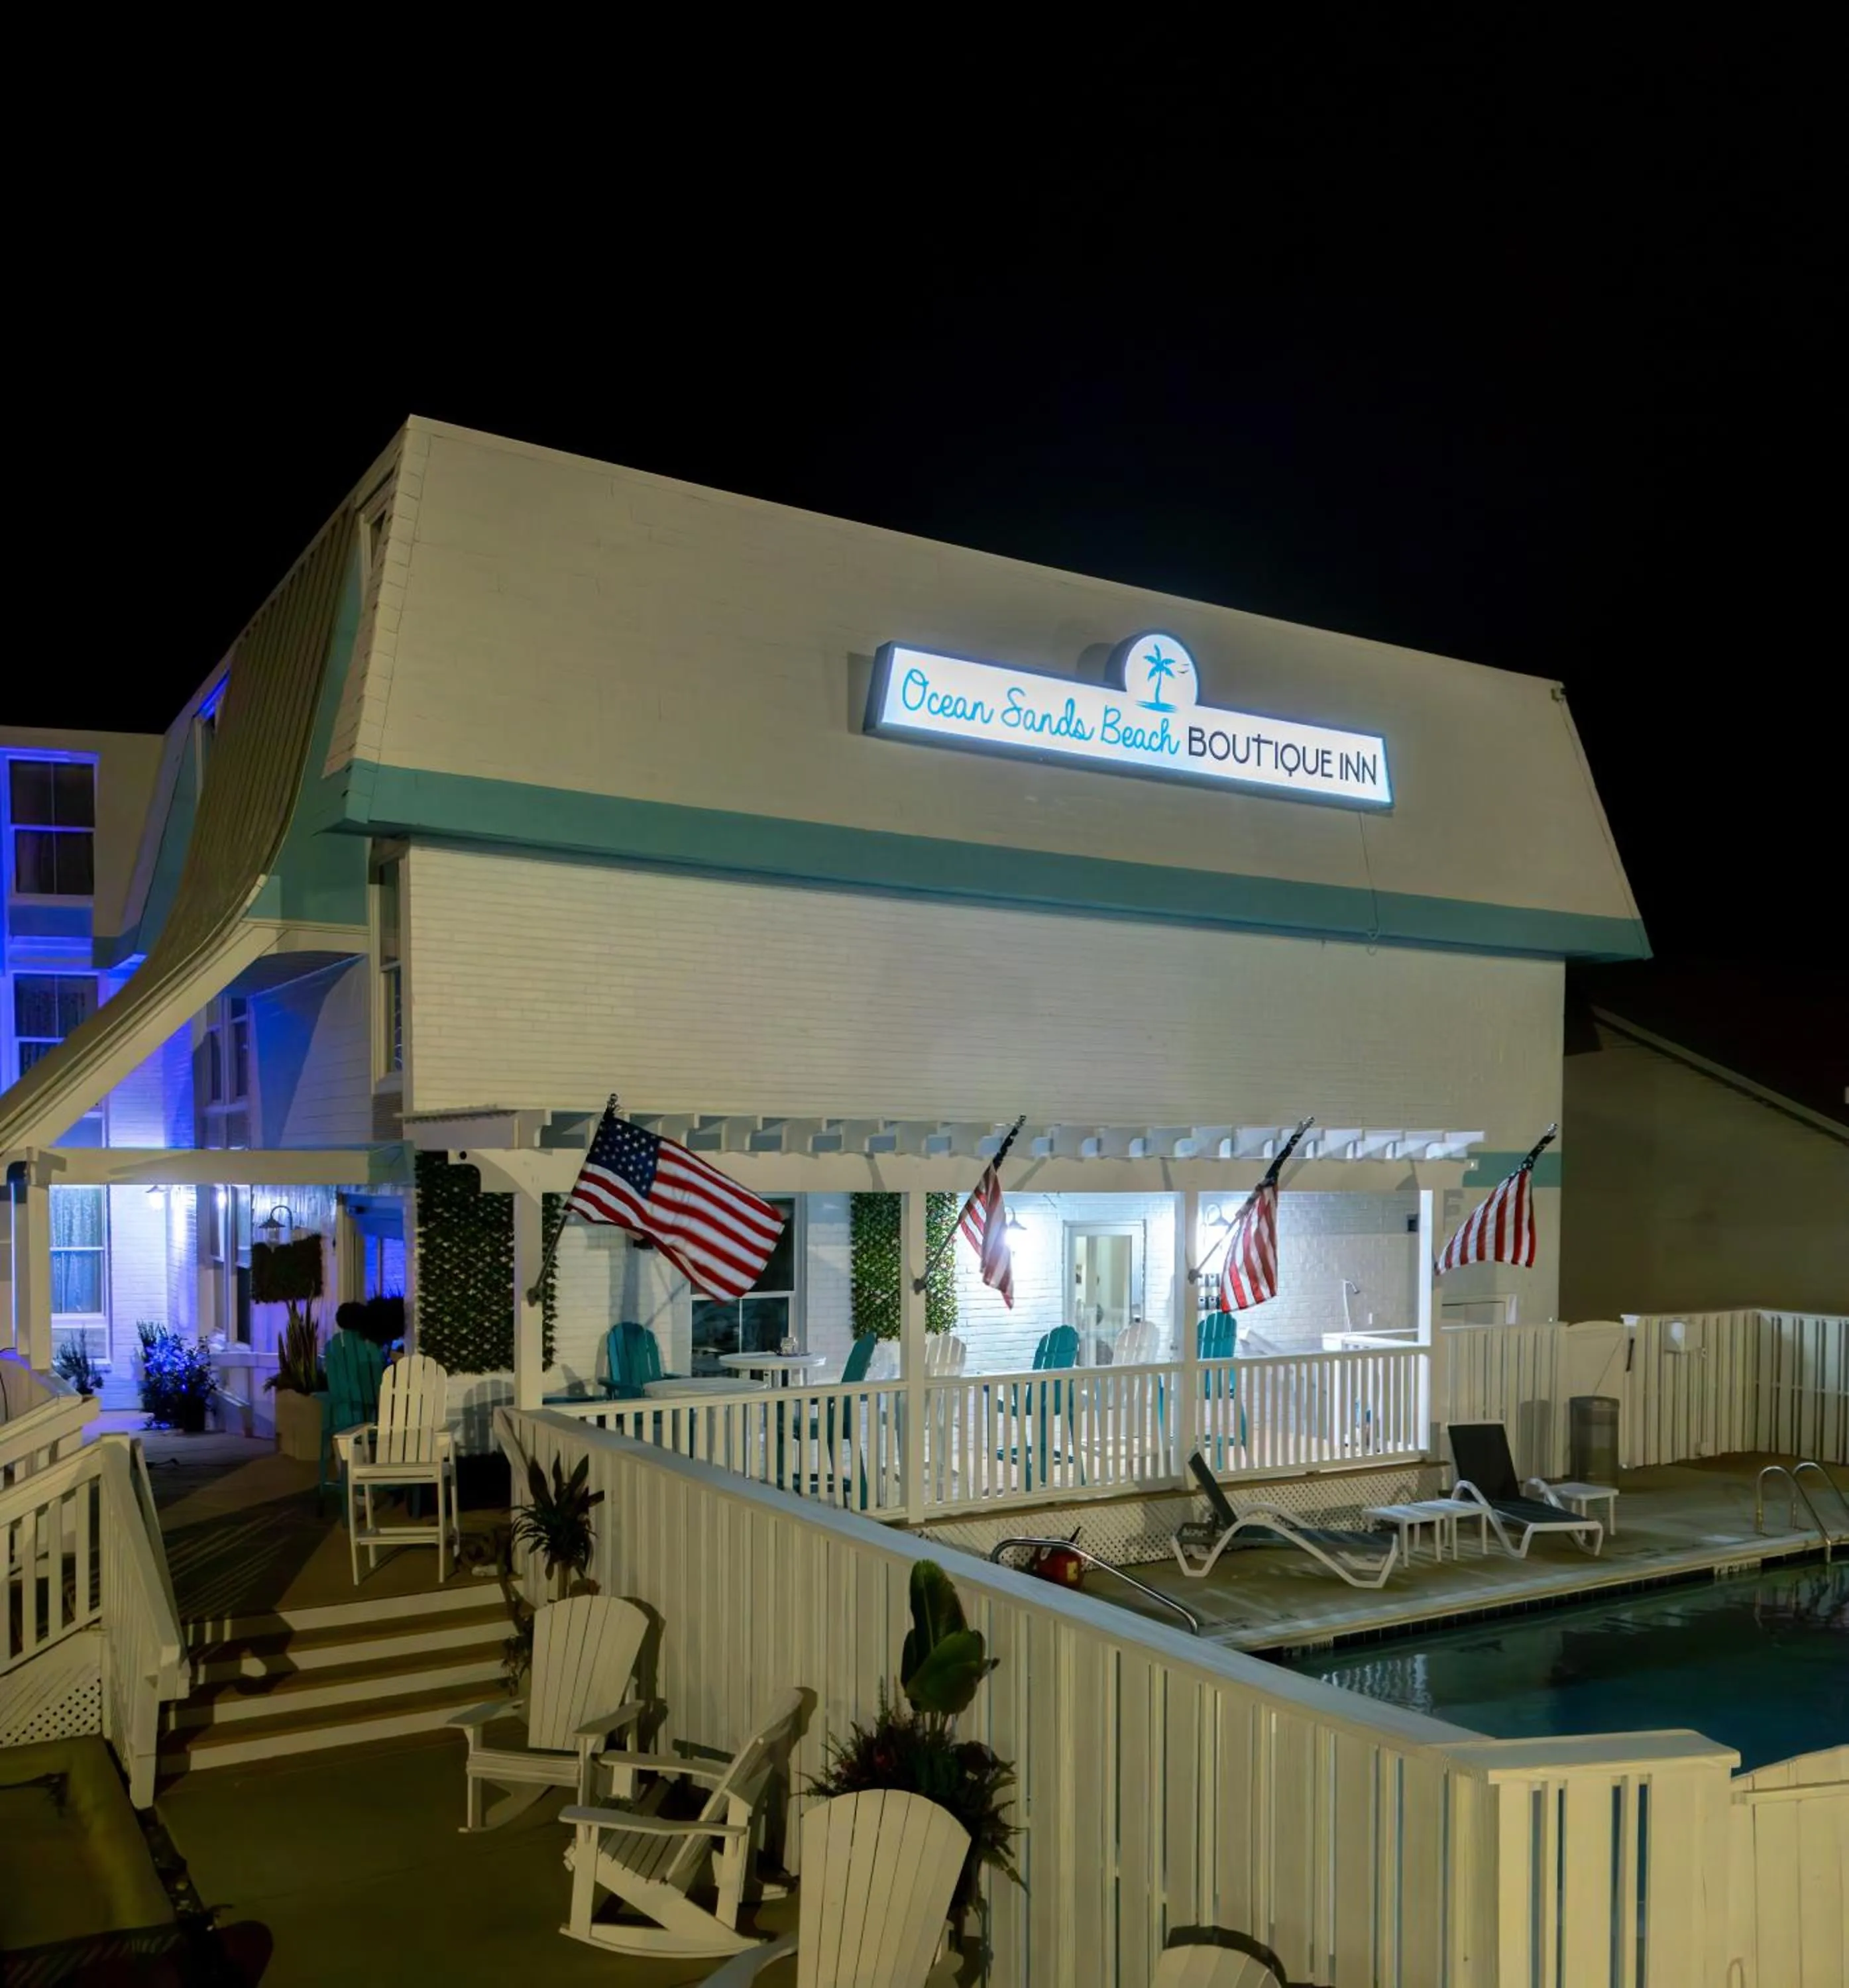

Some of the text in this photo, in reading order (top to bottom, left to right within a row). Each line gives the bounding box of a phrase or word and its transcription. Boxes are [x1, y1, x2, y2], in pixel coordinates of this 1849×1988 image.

[901, 668, 1378, 786] Ocean Sands Beach BOUTIQUE INN
